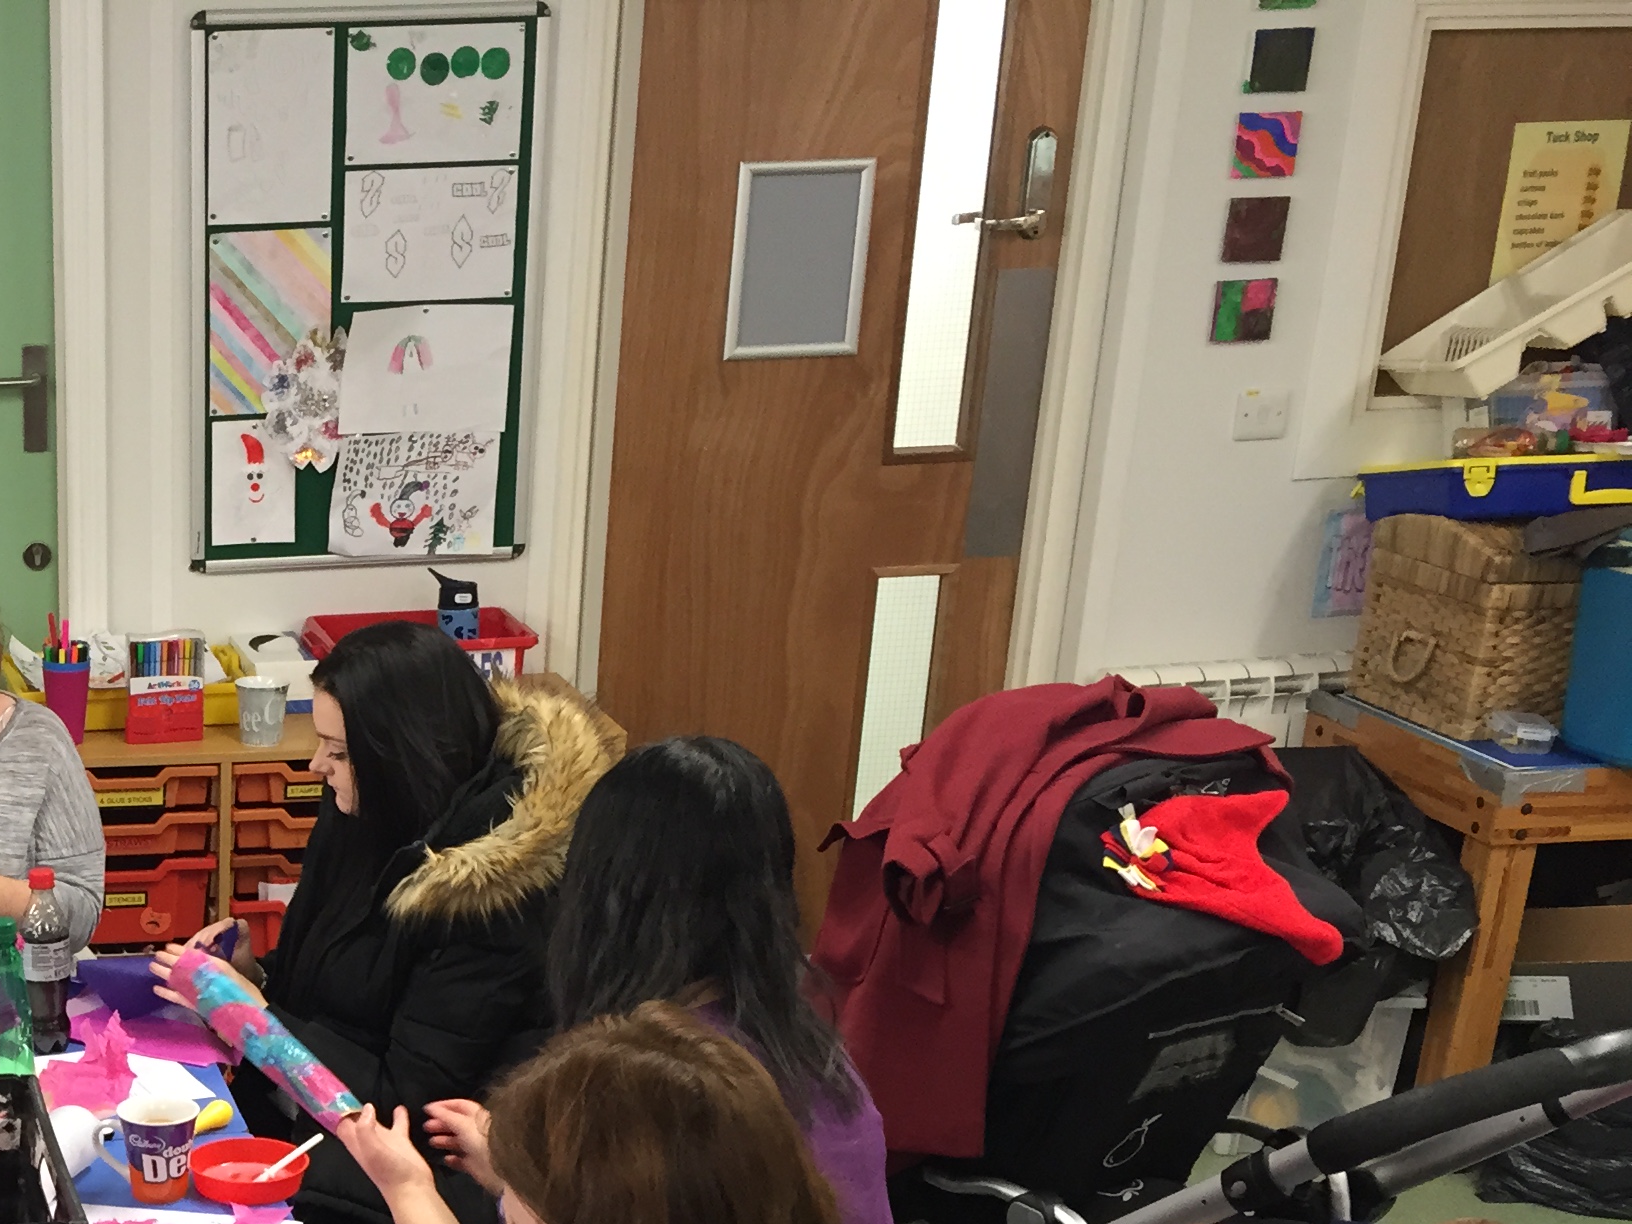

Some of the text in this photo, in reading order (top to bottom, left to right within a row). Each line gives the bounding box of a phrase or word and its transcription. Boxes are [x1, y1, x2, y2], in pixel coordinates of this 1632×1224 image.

[1546, 130, 1600, 144] Tuck Shop
[141, 1153, 191, 1183] De
